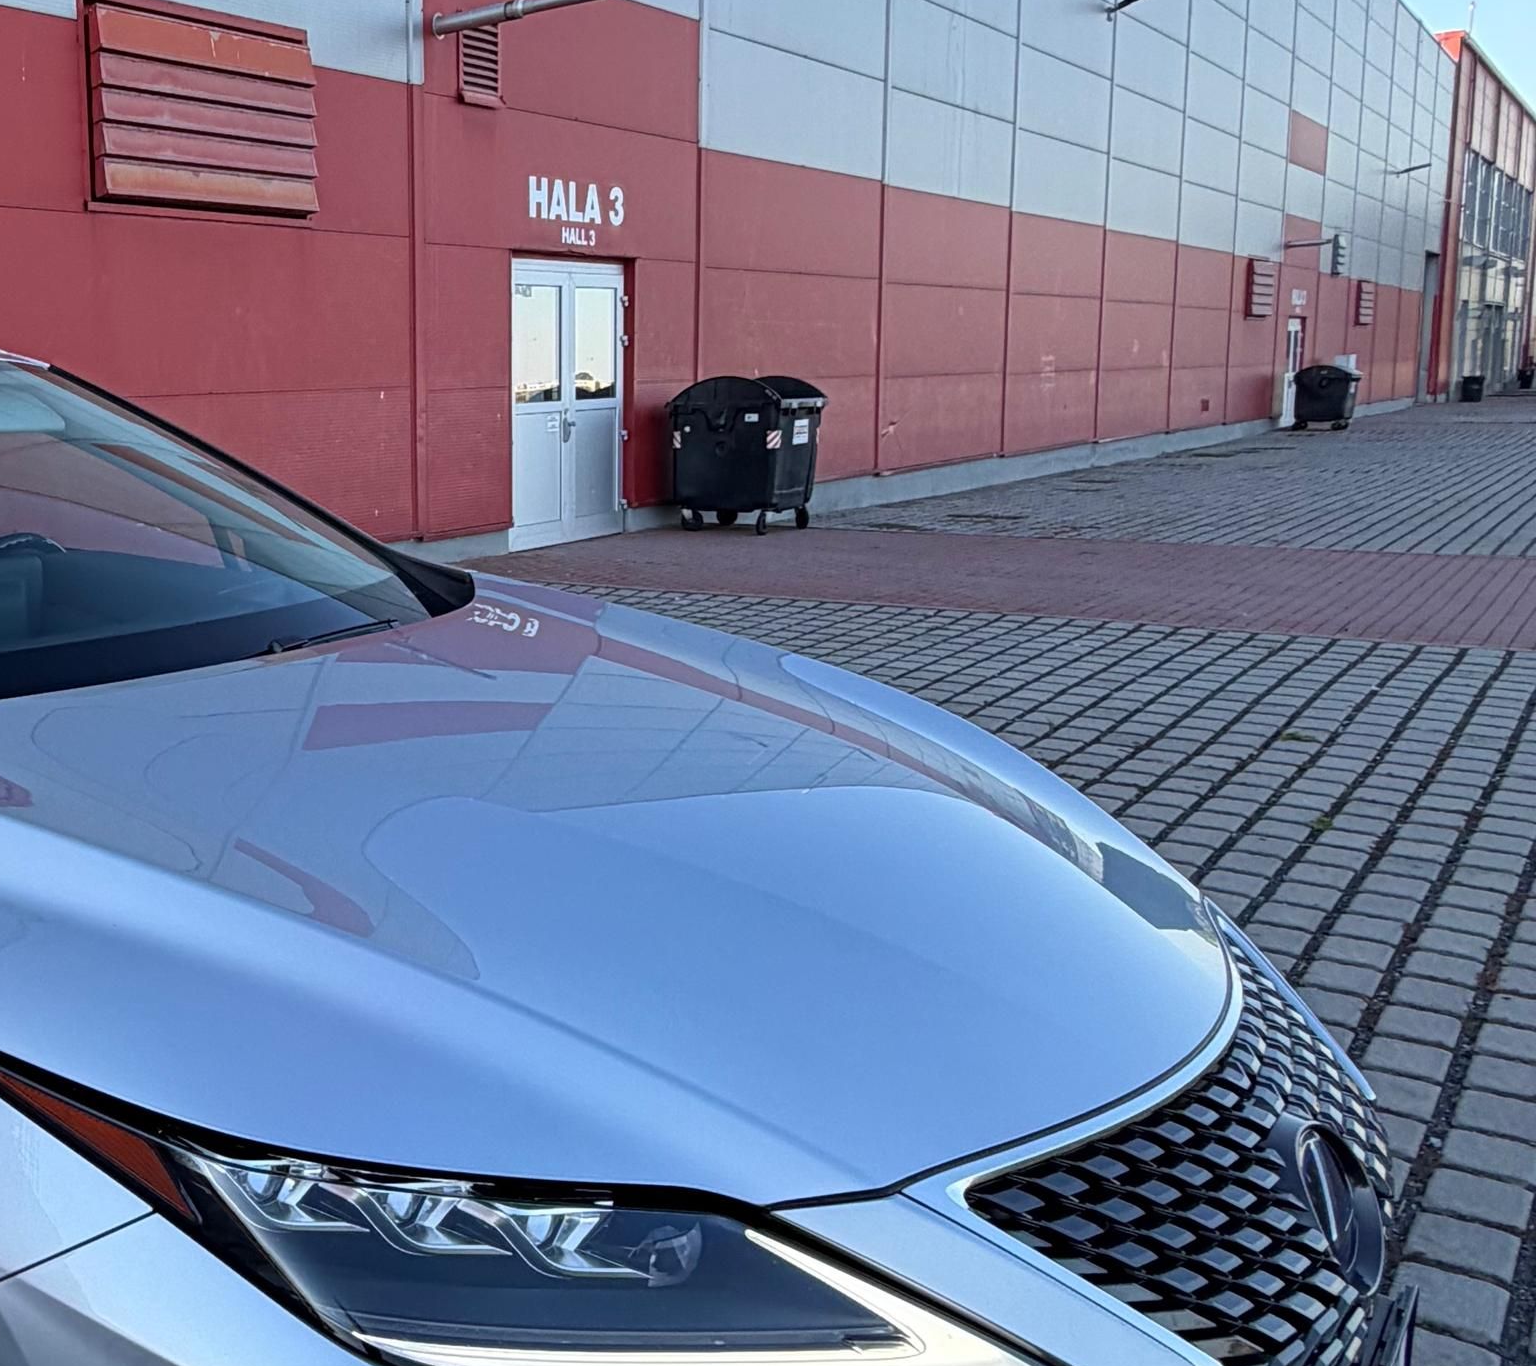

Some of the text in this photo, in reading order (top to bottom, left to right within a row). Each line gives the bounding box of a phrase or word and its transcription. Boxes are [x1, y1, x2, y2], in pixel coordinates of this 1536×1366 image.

[529, 175, 625, 227] HALA 3
[561, 226, 596, 247] HALL 3
